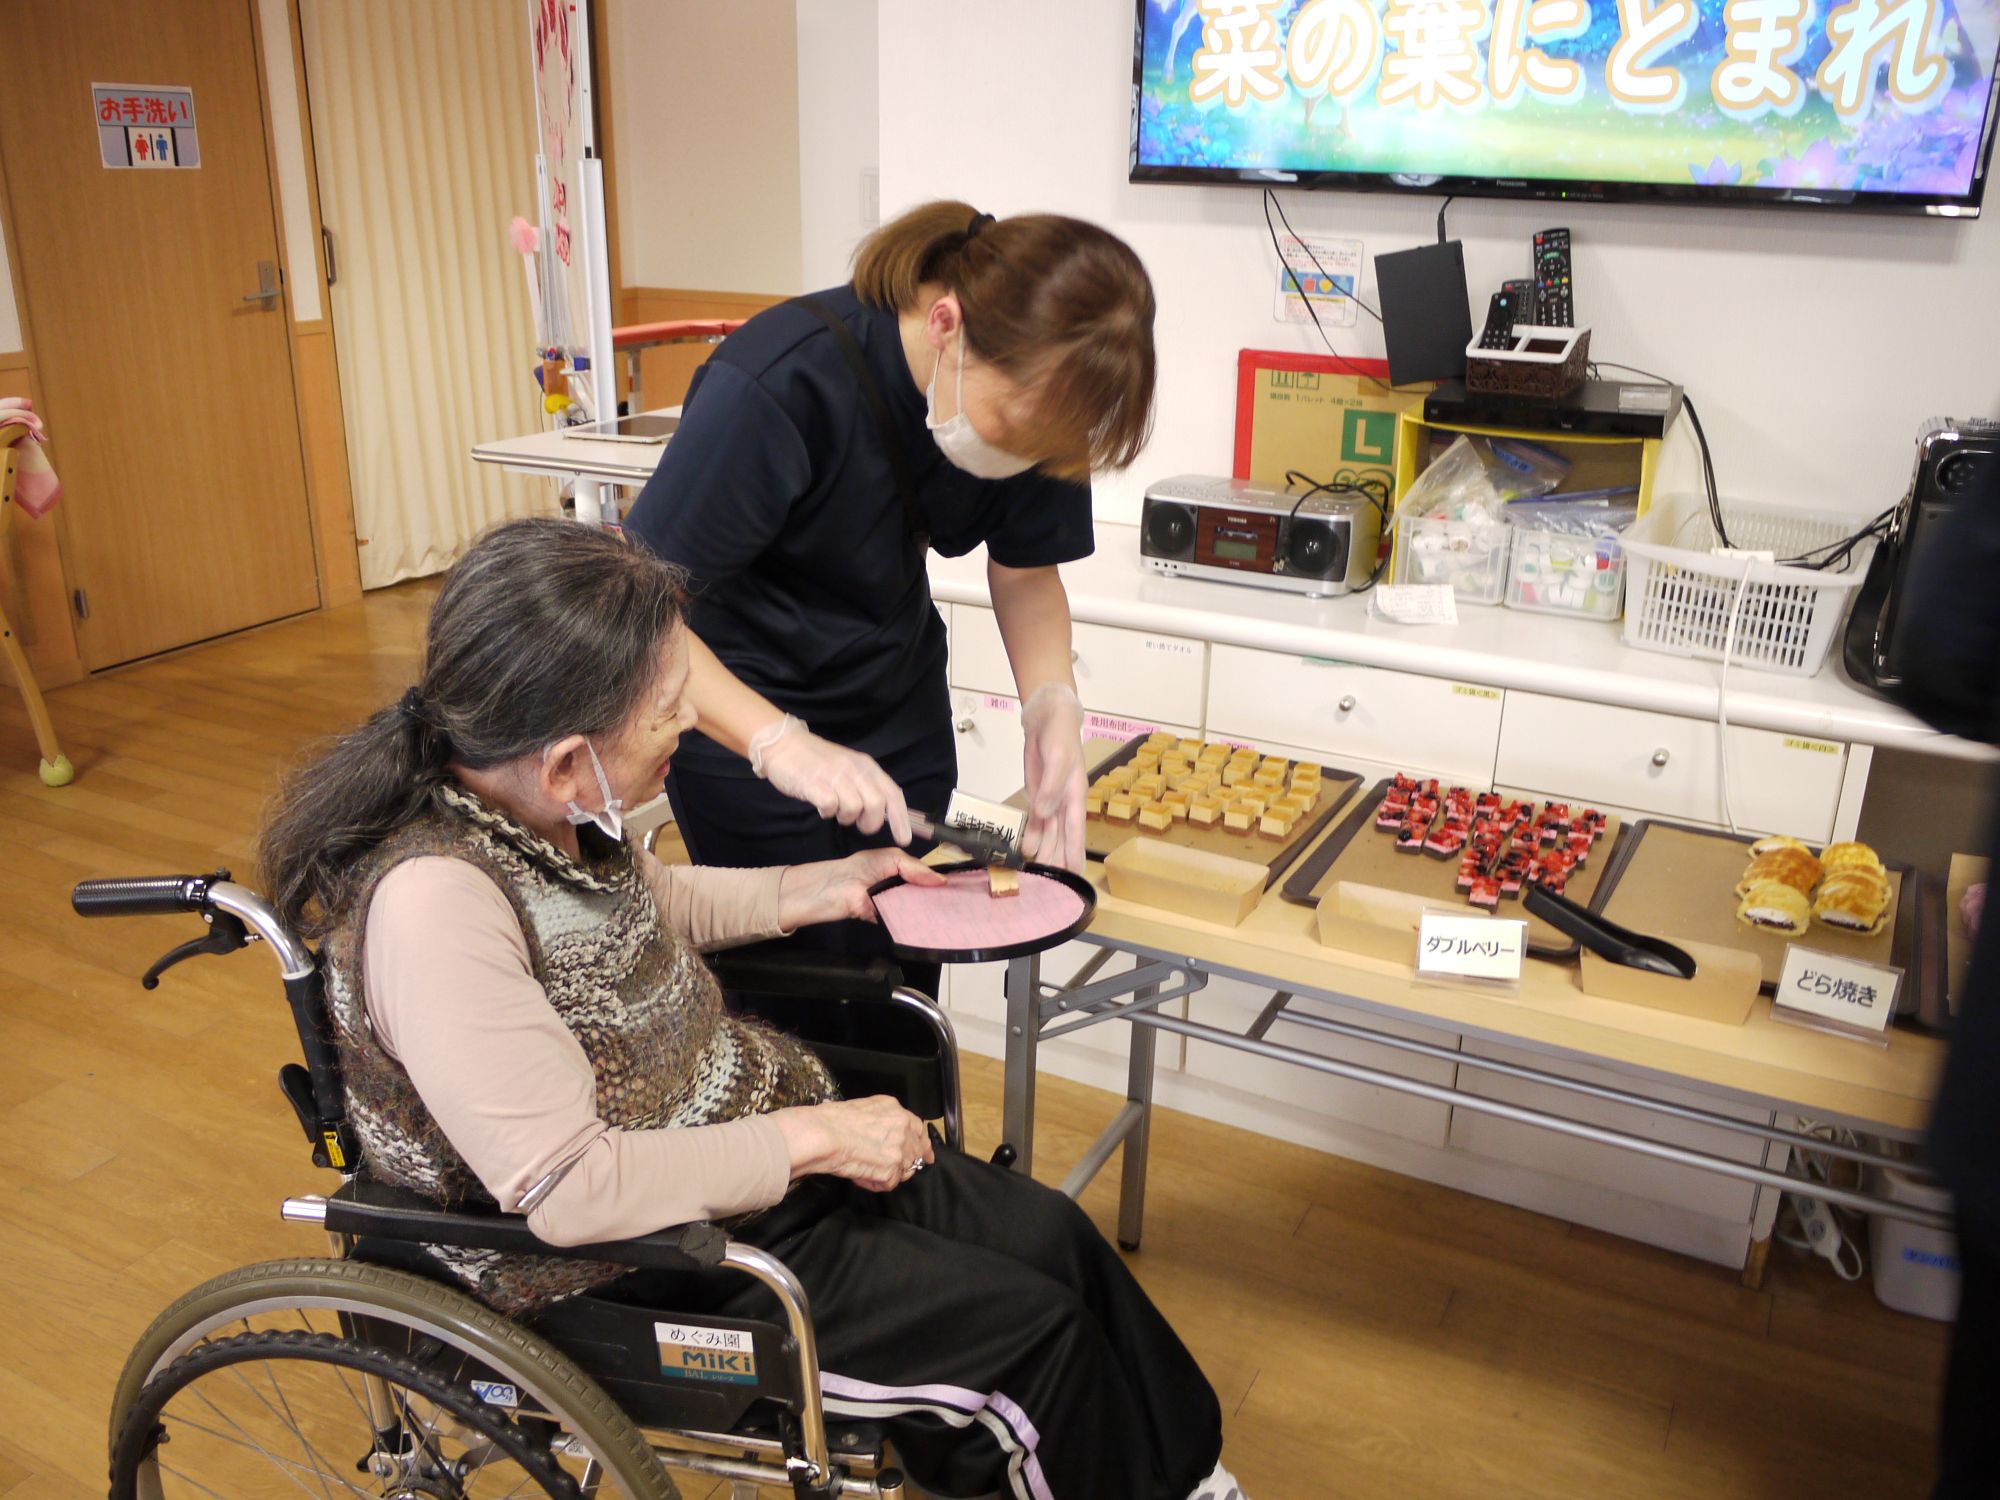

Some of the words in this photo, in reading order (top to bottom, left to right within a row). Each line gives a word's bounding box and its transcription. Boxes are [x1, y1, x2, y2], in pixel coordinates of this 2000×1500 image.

[1190, 0, 1952, 108] 菜の葉にとまれ
[100, 96, 188, 123] お手洗い
[1354, 417, 1382, 457] L
[954, 809, 1016, 842] 塩キャラメル
[1426, 935, 1516, 958] ダブルベリー
[1796, 968, 1878, 1009] どら焼き
[670, 1328, 741, 1349] めぐみ園
